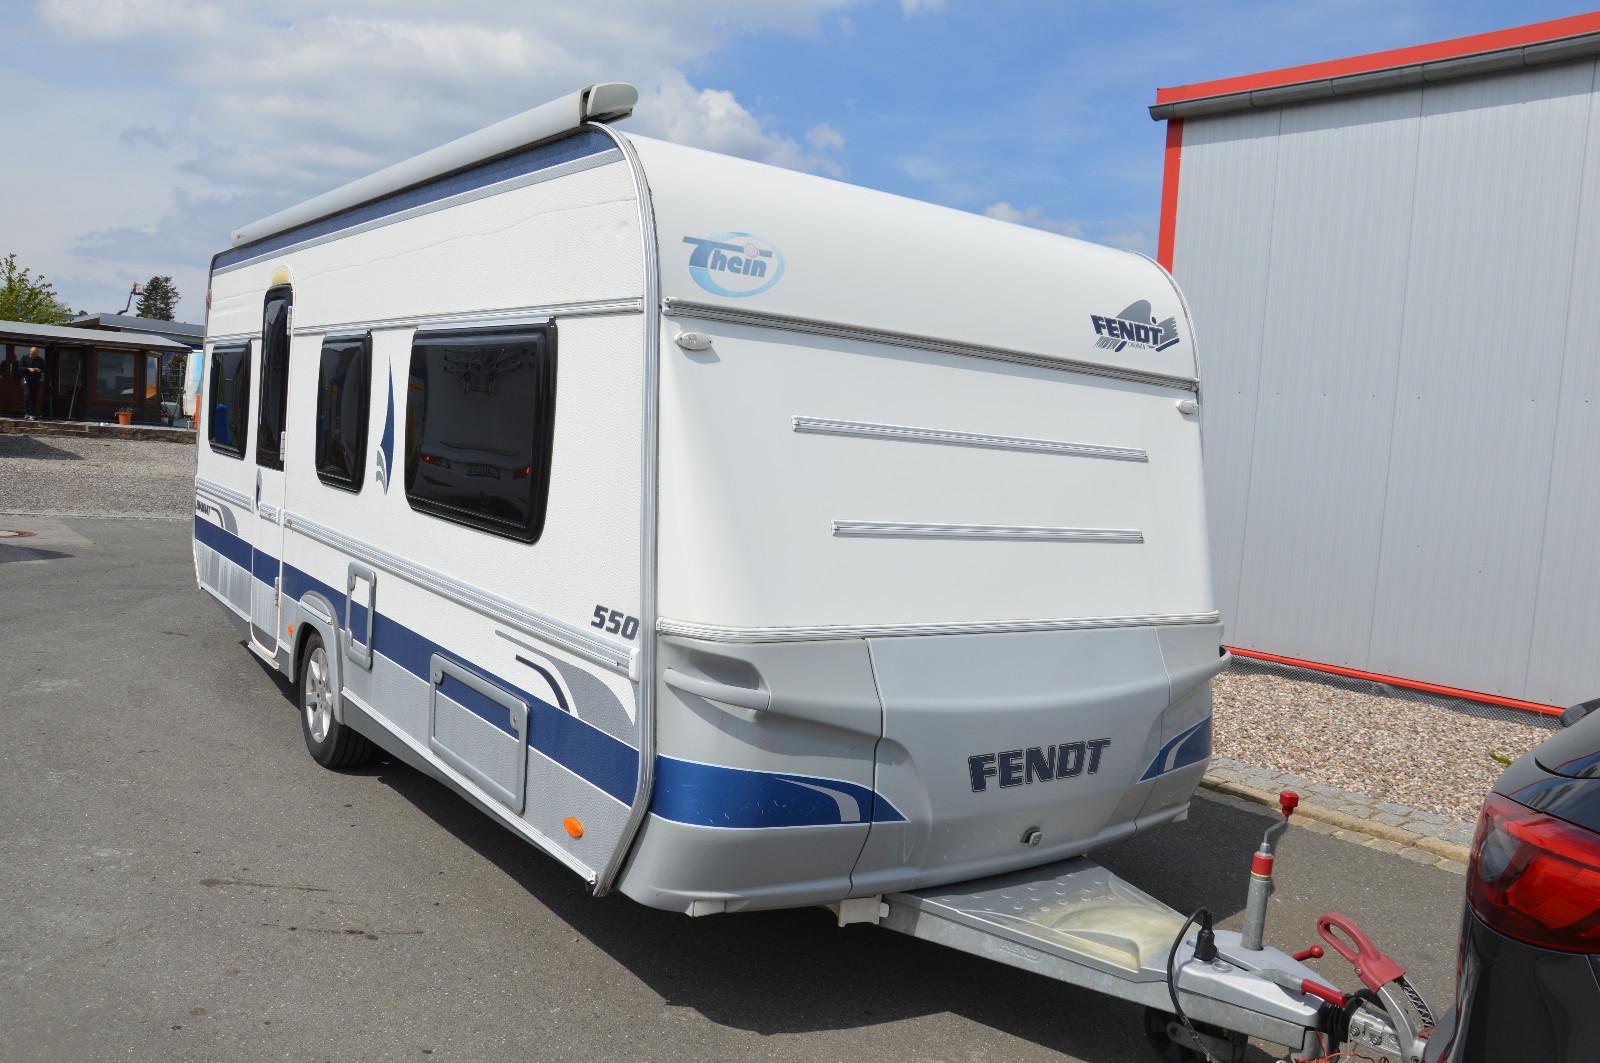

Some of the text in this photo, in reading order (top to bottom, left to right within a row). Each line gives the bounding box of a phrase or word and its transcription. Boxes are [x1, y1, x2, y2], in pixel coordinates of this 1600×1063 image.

[682, 236, 774, 278] Thein
[1090, 314, 1164, 346] FENDT
[591, 604, 640, 641] 550
[968, 738, 1112, 793] FENDT
